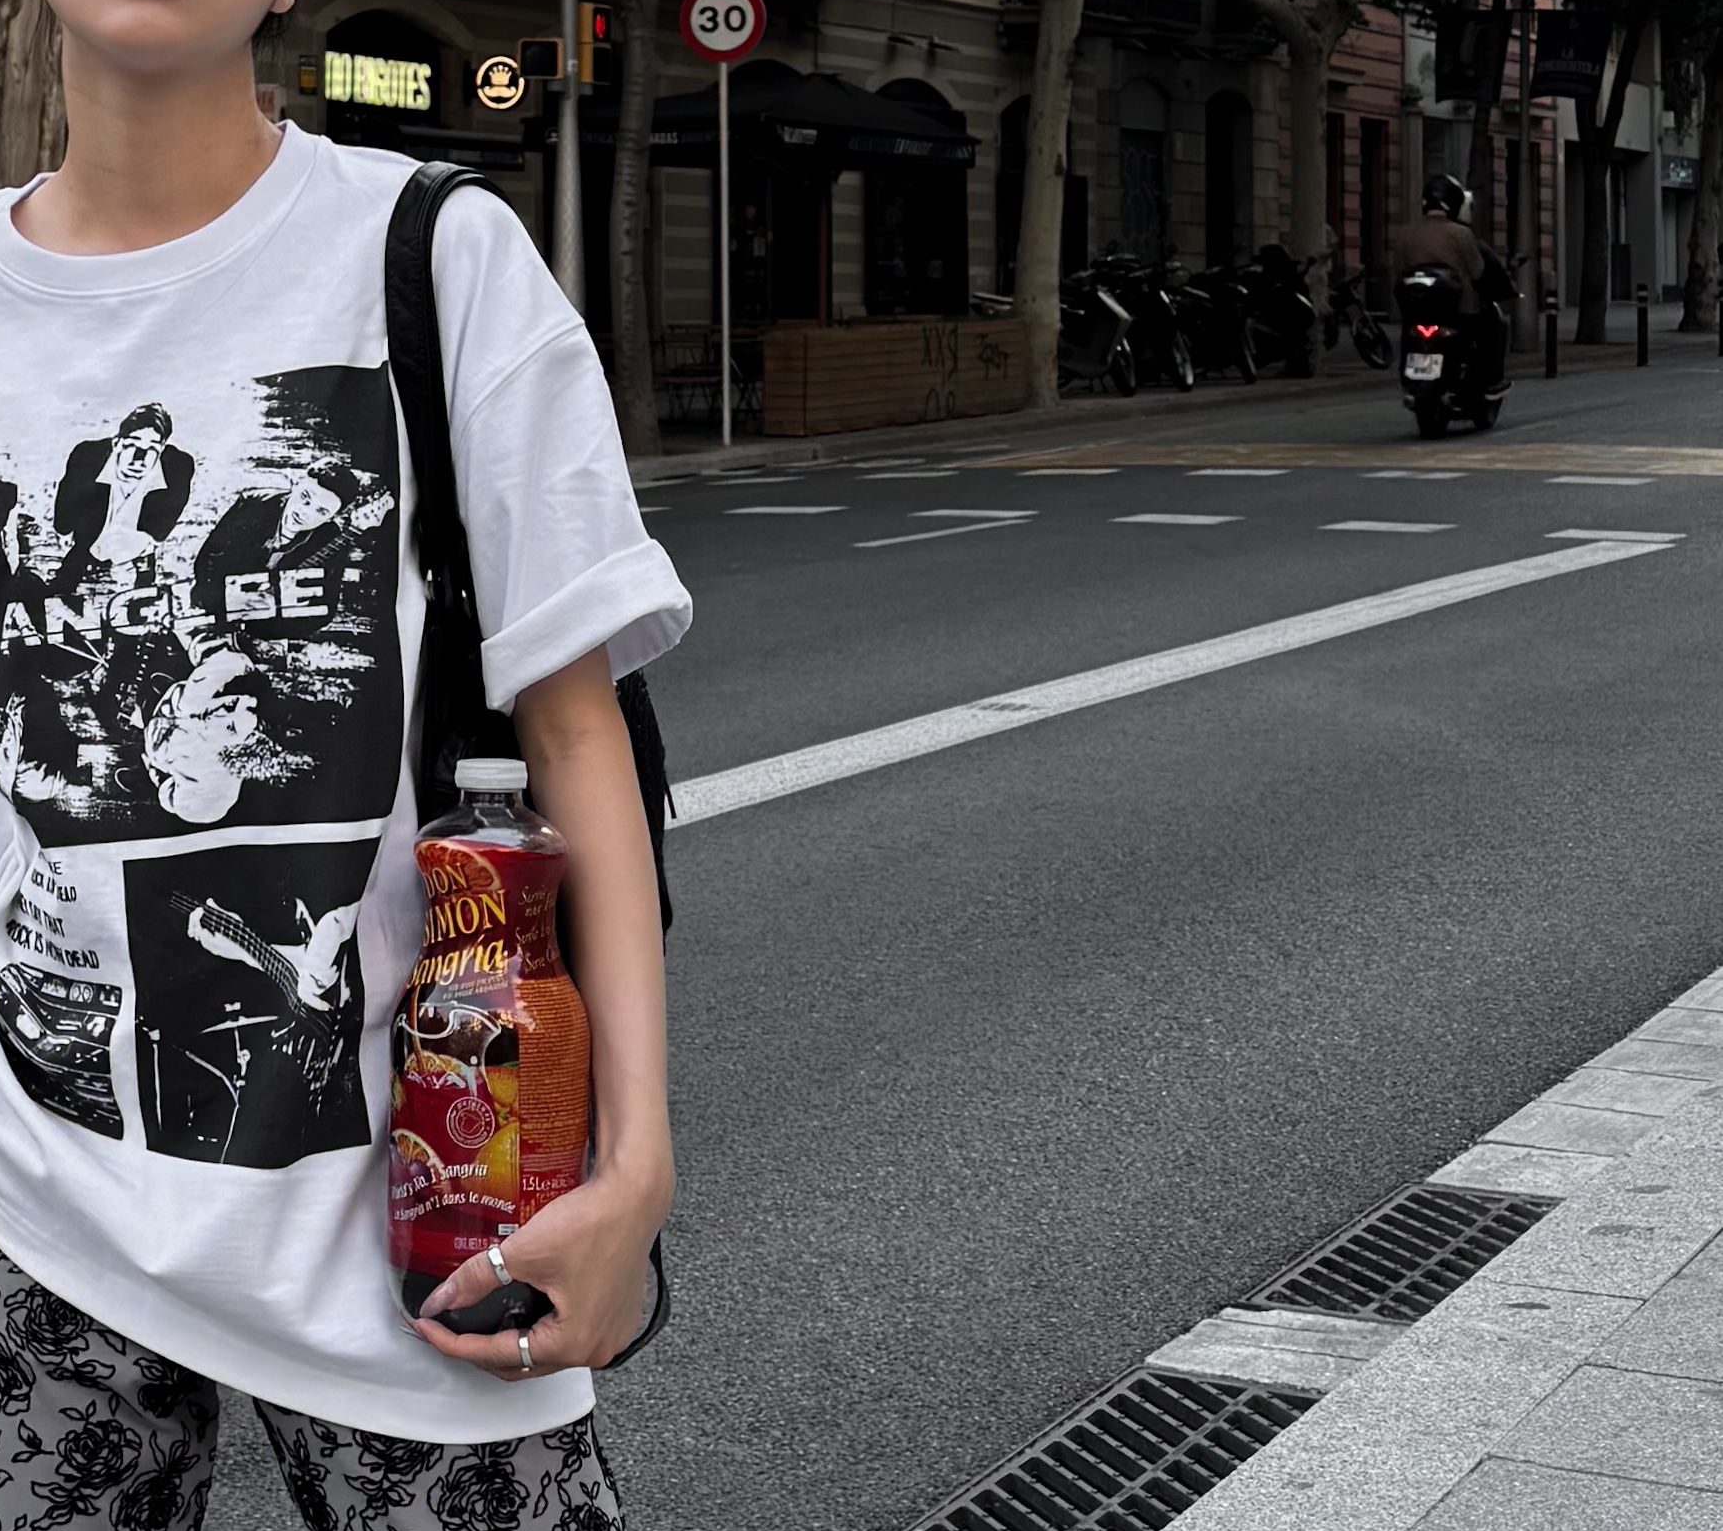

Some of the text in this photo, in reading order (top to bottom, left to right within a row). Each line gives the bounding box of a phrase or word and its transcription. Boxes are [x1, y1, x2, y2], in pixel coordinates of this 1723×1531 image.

[697, 5, 747, 34] 30
[423, 863, 469, 900] DON
[35, 931, 44, 954] IS
[64, 949, 99, 969] DEAD
[439, 1163, 489, 1181] Sangria
[442, 1193, 466, 1207] dans
[469, 1190, 480, 1204] le
[481, 1194, 517, 1215] monde
